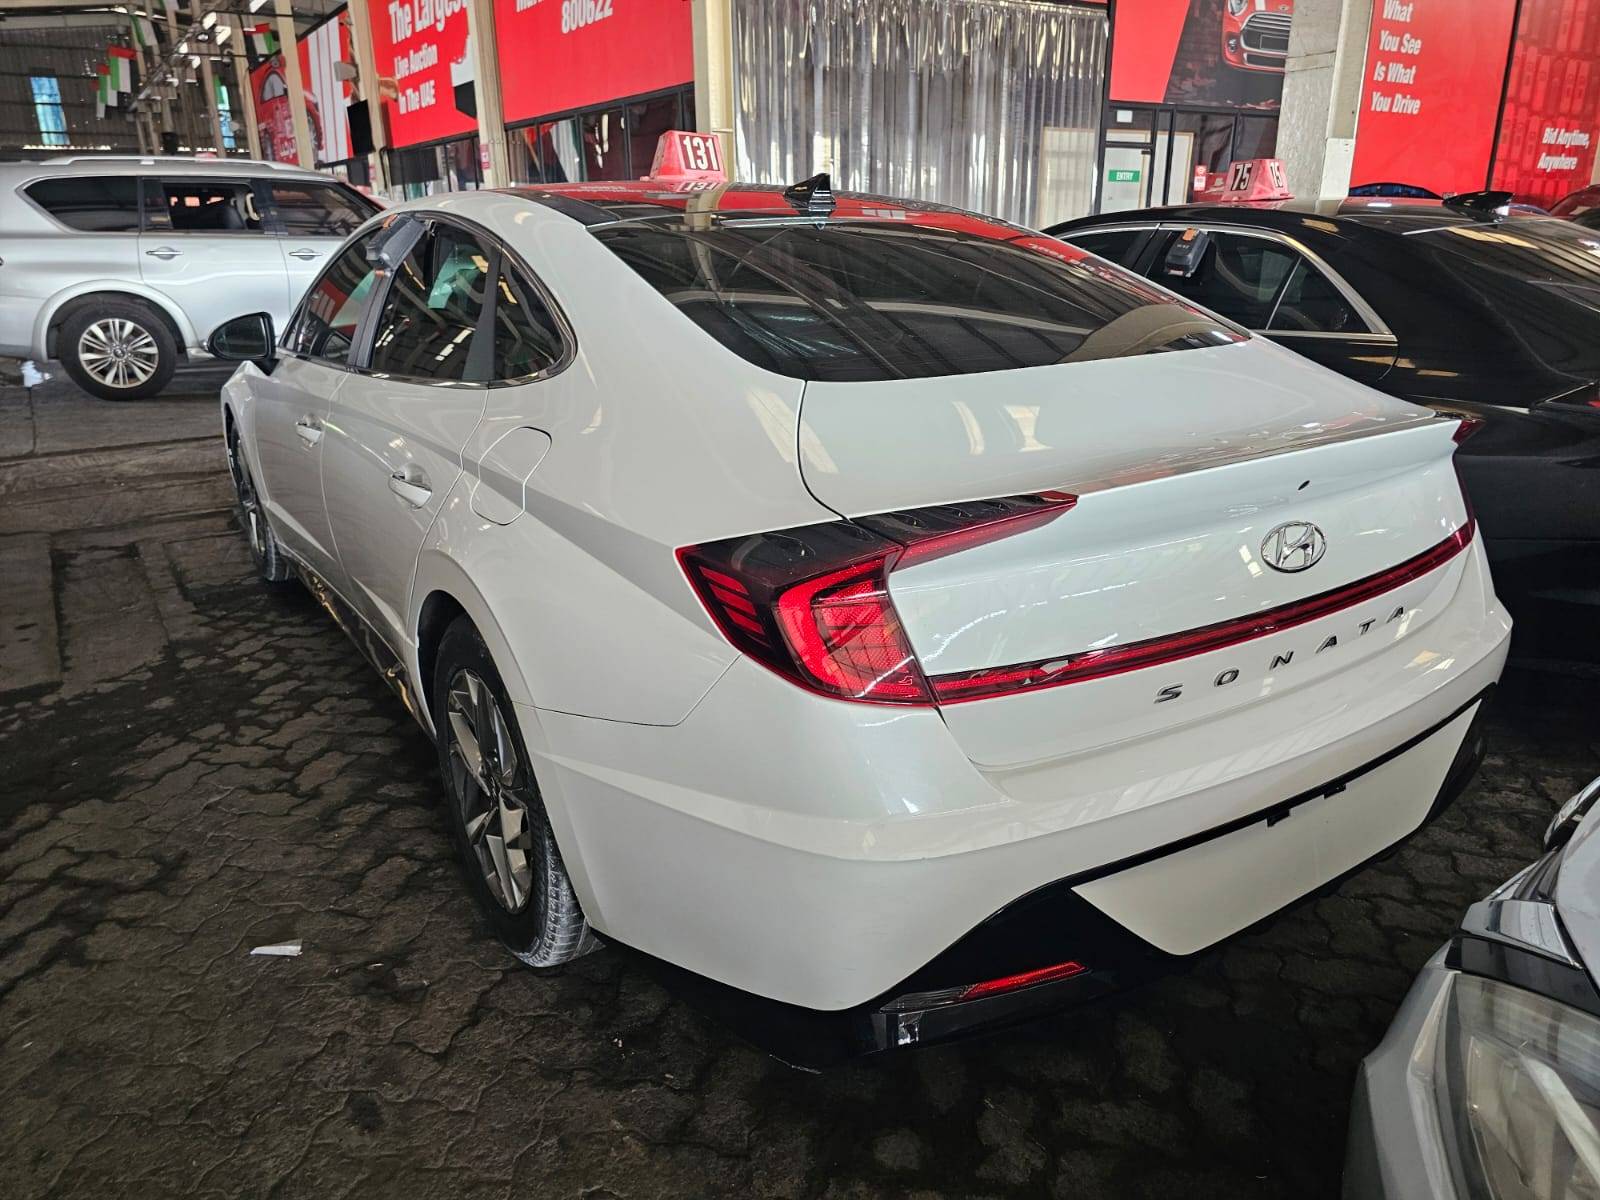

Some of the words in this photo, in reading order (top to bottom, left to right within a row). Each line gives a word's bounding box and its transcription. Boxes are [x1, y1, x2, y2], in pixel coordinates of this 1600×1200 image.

[388, 1, 413, 45] The
[414, 0, 468, 32] Large
[561, 0, 614, 34] 800622
[1382, 0, 1413, 23] What
[1379, 30, 1400, 52] You
[1400, 33, 1422, 55] See
[1373, 61, 1386, 81] Is
[1387, 62, 1416, 85] What
[405, 88, 420, 112] The
[419, 80, 436, 108] UAE
[1371, 91, 1392, 112] You
[1391, 93, 1421, 115] Drive
[1542, 127, 1559, 144] Bid
[683, 135, 719, 171] 131
[1537, 152, 1578, 173] Anywhere
[1116, 171, 1134, 182] ENTRY
[1231, 163, 1252, 191] 75
[1153, 606, 1404, 704] SONATA
